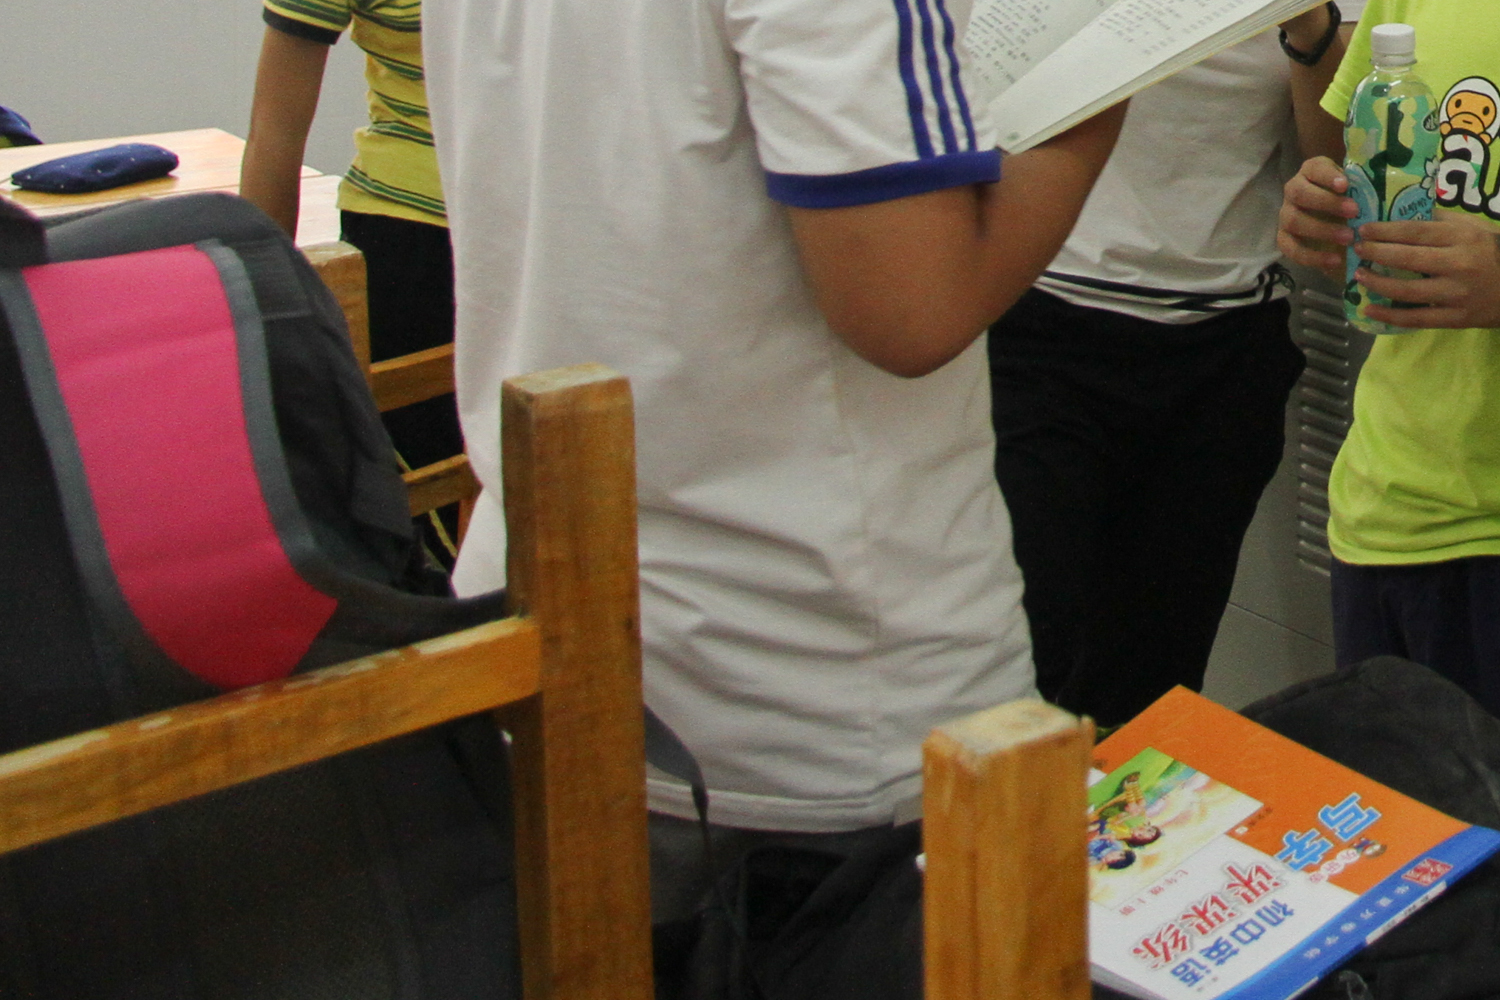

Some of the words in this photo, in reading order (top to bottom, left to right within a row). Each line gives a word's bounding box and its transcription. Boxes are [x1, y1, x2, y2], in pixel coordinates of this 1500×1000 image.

[1272, 792, 1381, 871] 写字
[1131, 860, 1288, 969] 课课练
[1169, 898, 1296, 989] 初中英语
